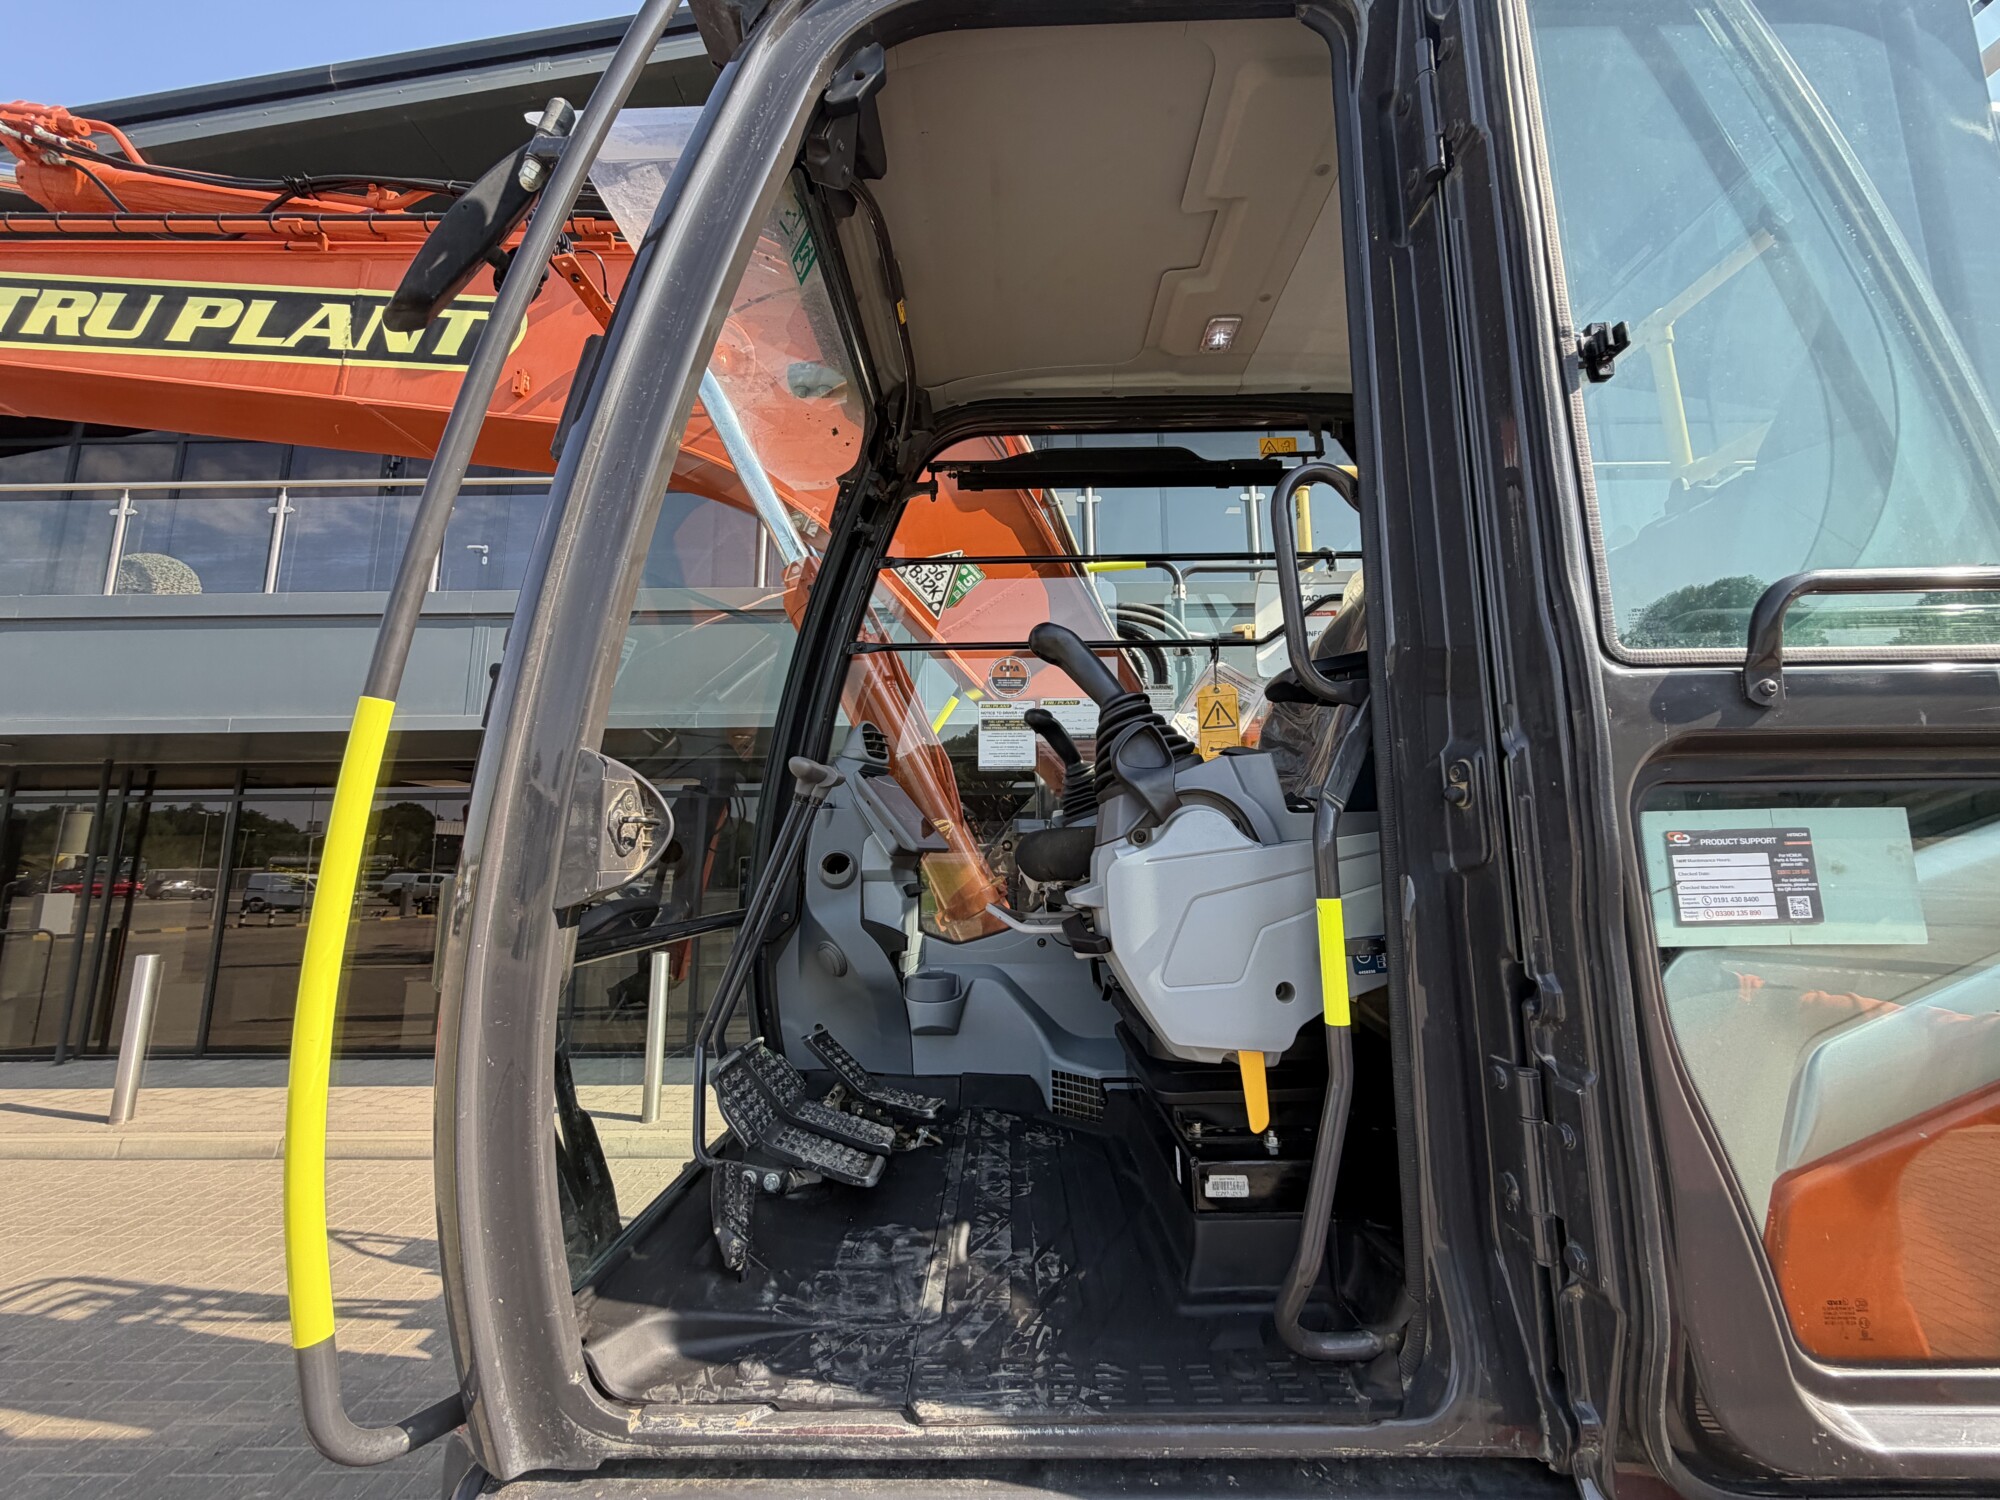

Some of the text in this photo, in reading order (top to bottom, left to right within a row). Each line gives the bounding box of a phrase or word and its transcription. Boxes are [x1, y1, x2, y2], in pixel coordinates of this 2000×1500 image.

[0, 288, 489, 357] TRU PLANT
[909, 565, 943, 600] BJ2K
[963, 575, 976, 587] 5
[1700, 838, 1738, 846] PRODUCT
[1739, 837, 1777, 845] SUPPORT
